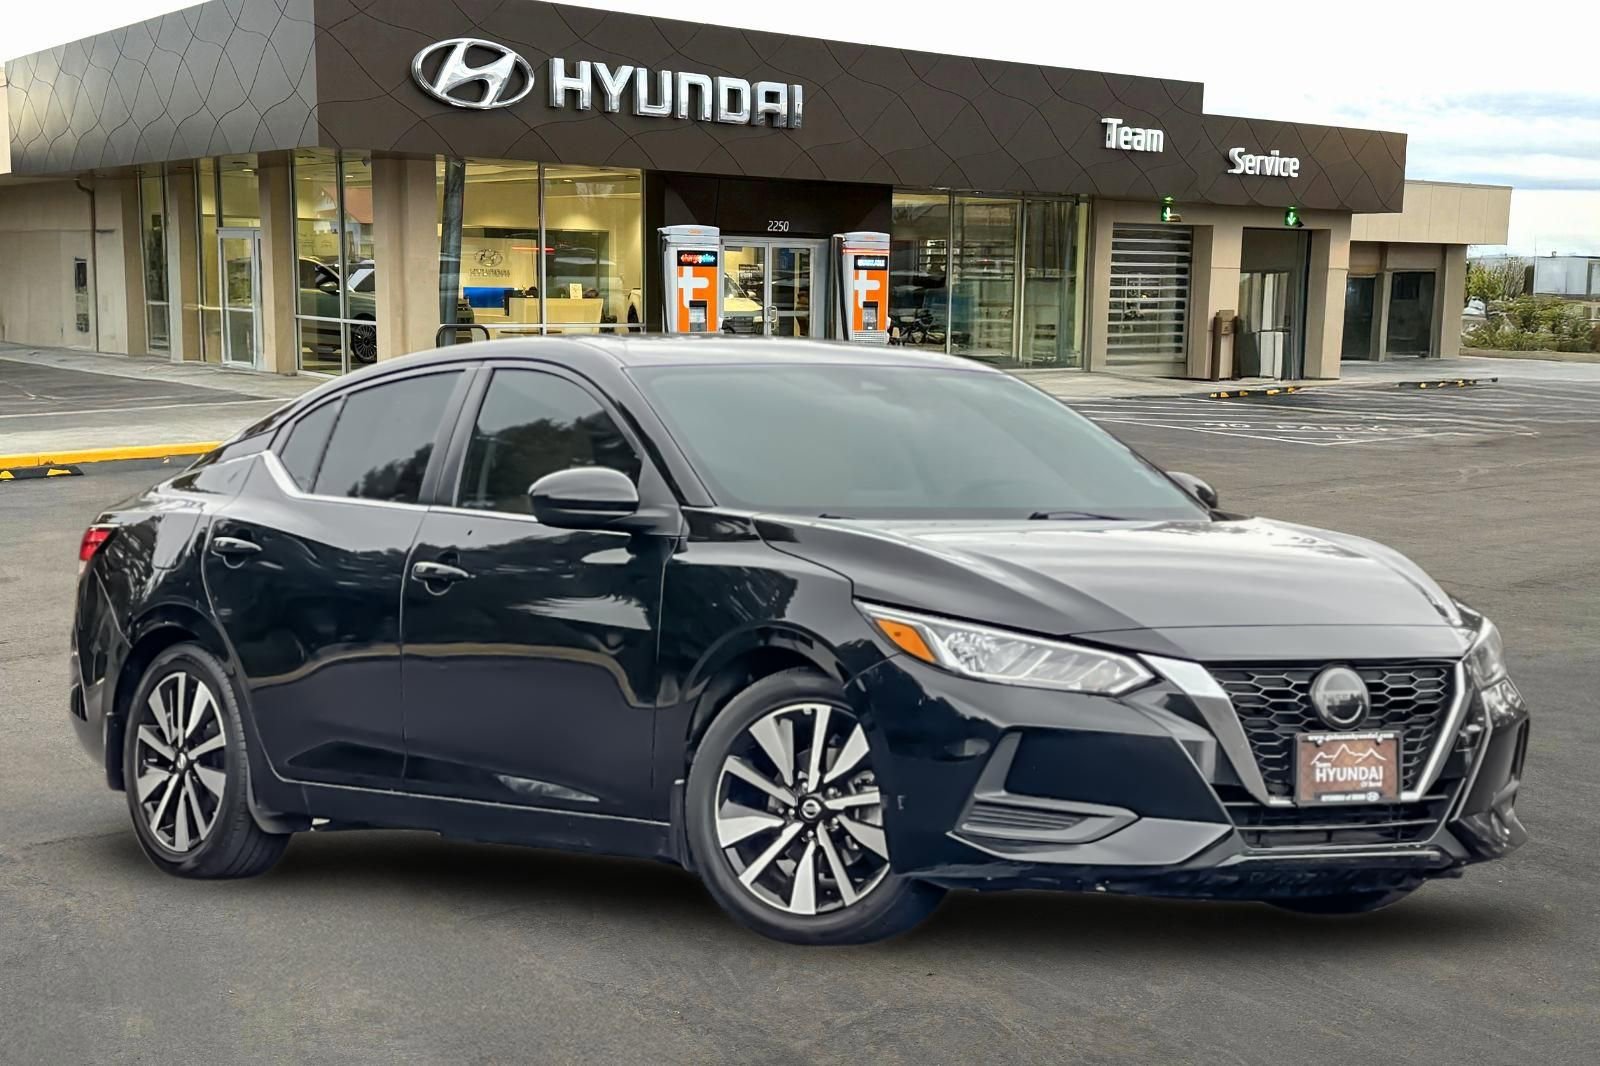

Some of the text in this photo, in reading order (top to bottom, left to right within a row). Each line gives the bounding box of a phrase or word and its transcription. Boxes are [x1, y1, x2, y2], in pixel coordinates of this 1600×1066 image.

[549, 57, 803, 129] HYUNDAI
[1101, 117, 1164, 153] Team
[1227, 147, 1300, 178] Service
[767, 220, 790, 232] 2250
[1315, 766, 1384, 783] HYUNDAI
